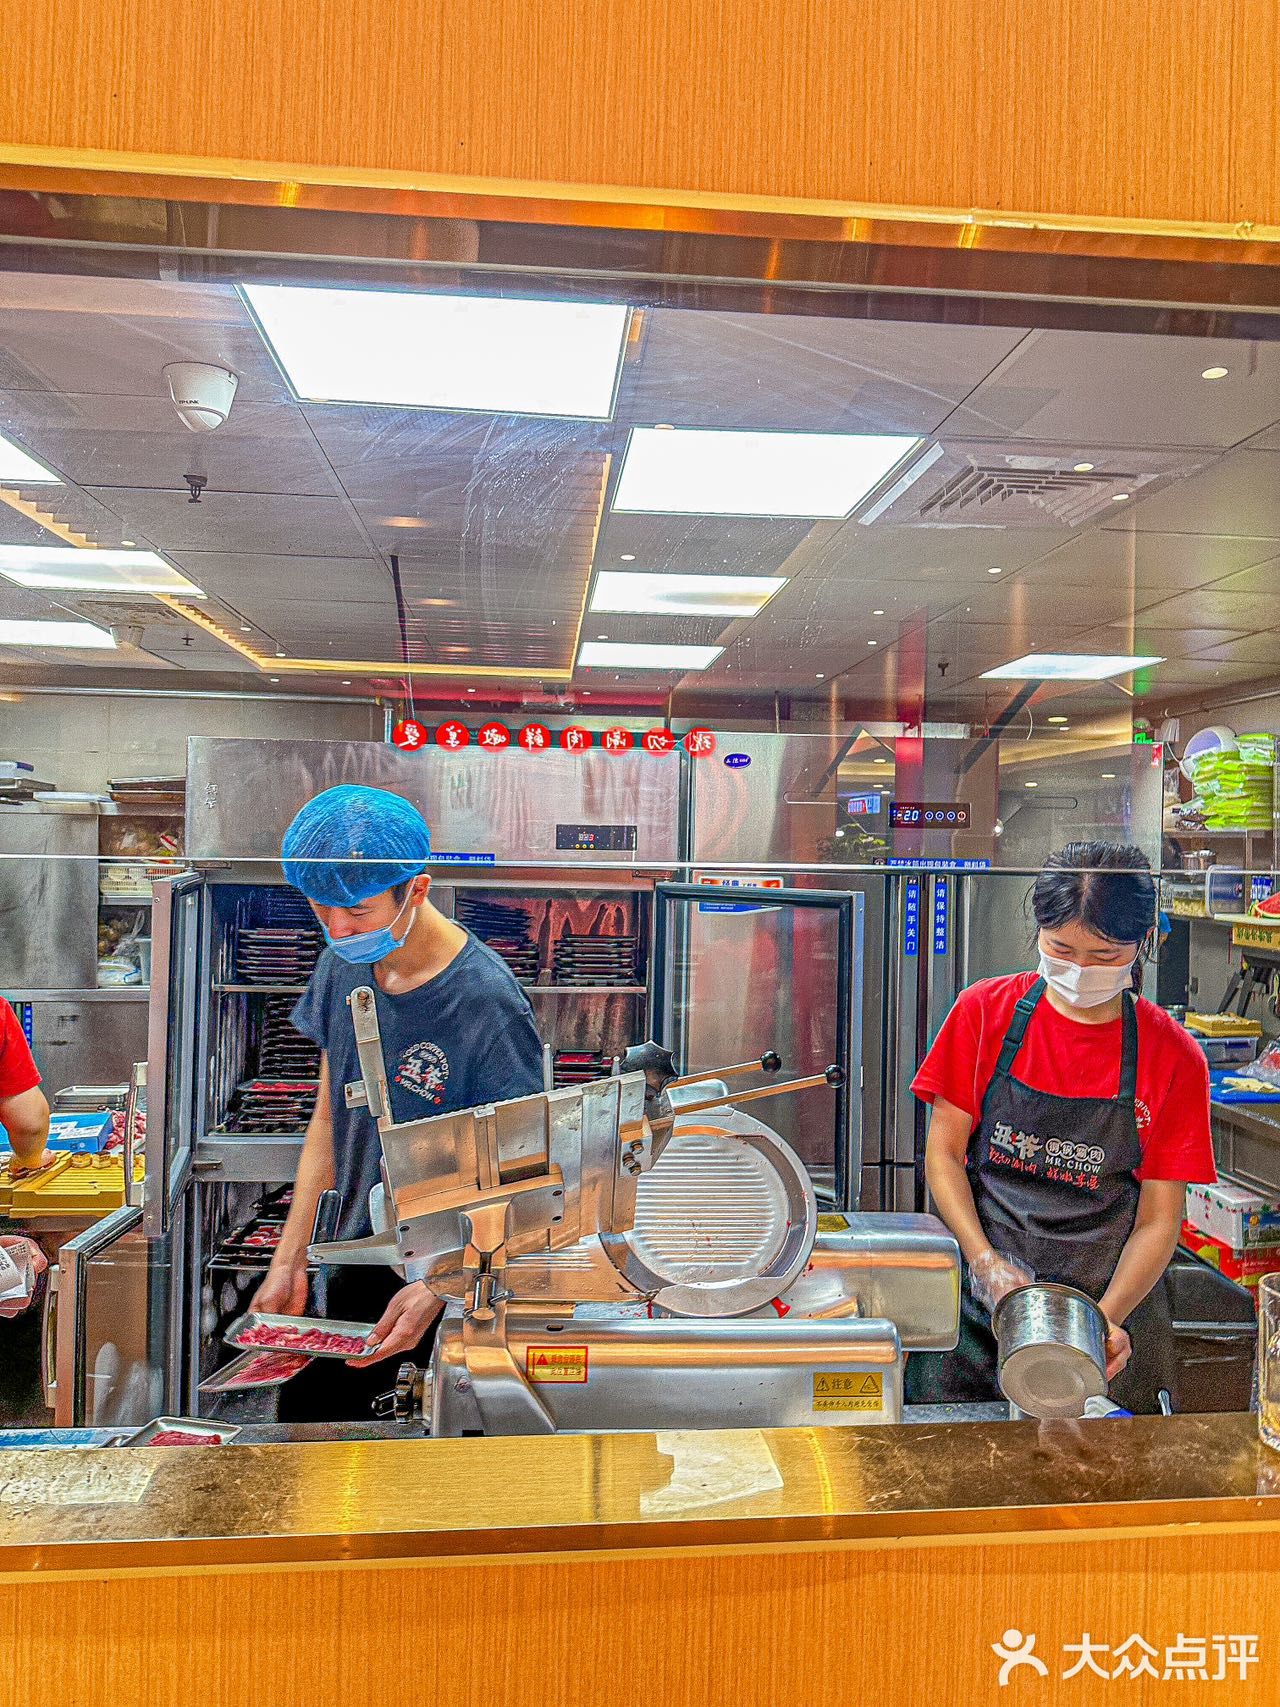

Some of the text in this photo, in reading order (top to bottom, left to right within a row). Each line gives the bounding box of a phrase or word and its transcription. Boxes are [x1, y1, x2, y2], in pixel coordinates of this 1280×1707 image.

[906, 889, 917, 951] 请随手关门
[935, 888, 946, 950] 请保持整洁
[831, 1377, 853, 1391] 注意
